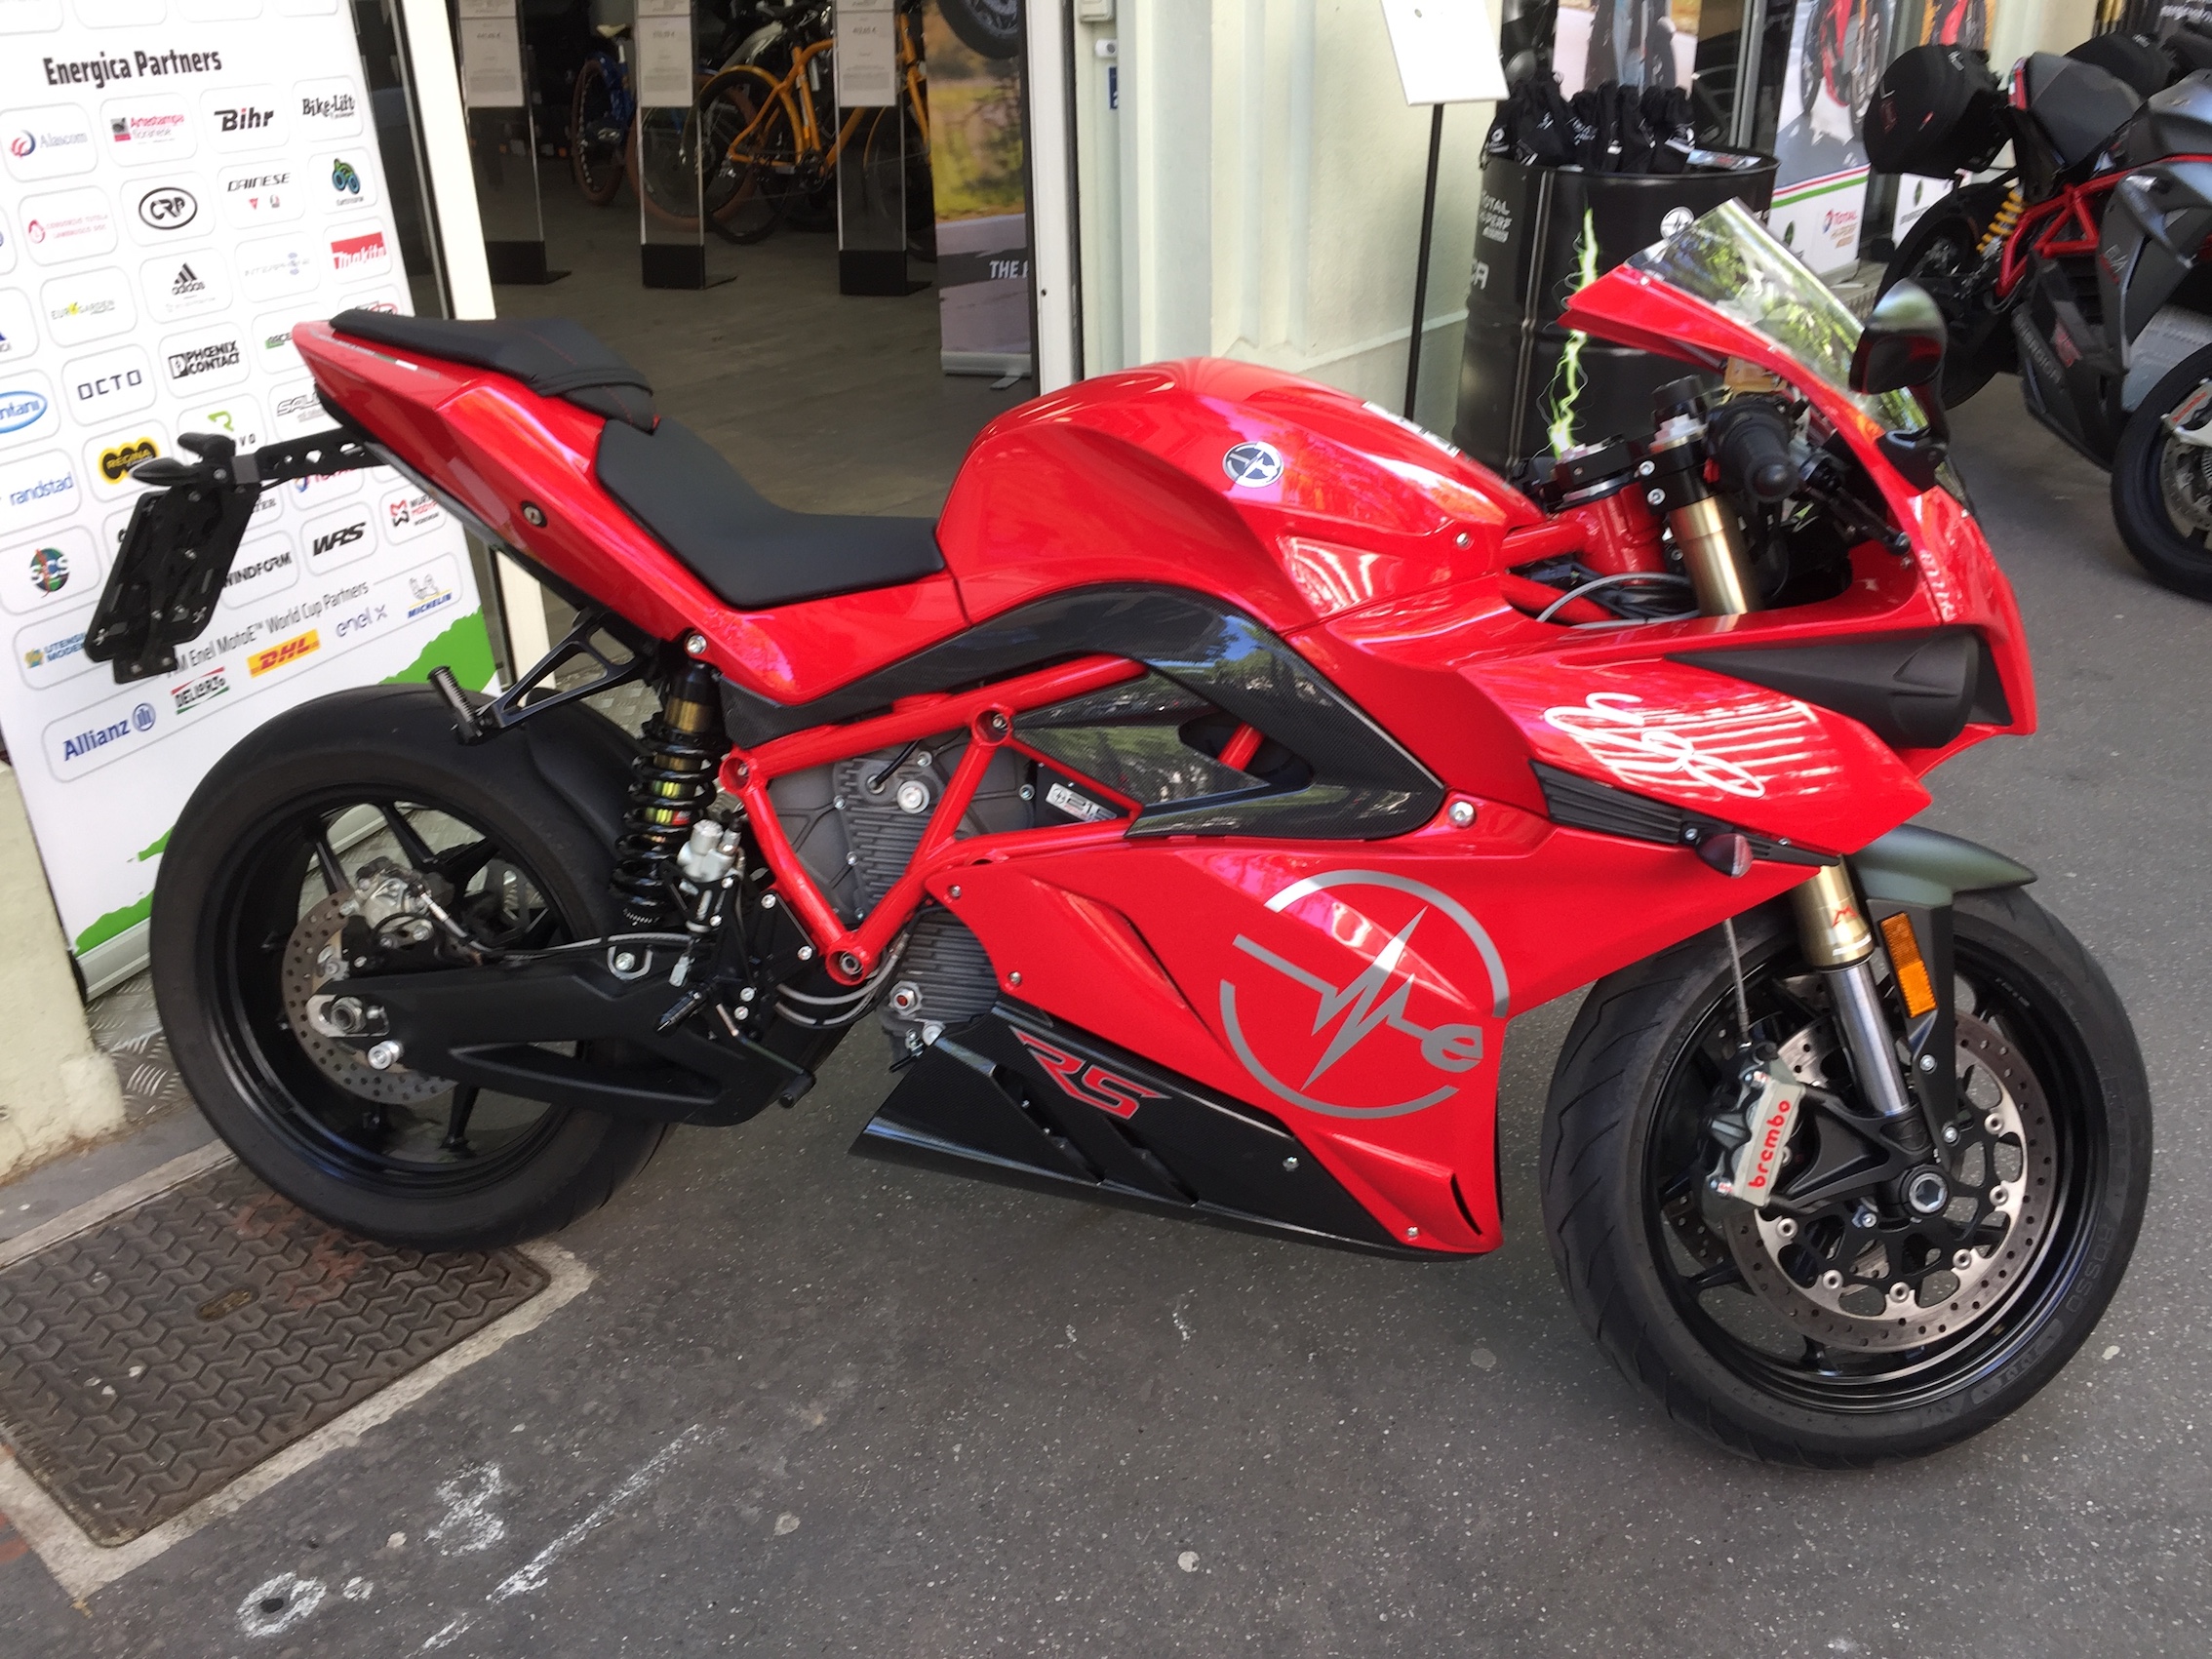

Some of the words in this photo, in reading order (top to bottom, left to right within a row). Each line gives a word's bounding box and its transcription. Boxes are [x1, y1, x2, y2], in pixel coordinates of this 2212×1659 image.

[43, 52, 132, 89] Energica
[135, 48, 222, 78] Partners
[214, 107, 274, 132] Bihr
[227, 173, 291, 192] DAINESE
[150, 197, 186, 219] CRP
[989, 259, 1020, 280] THE
[172, 280, 206, 296] adidas
[77, 370, 142, 400] OCTO
[10, 472, 74, 505] randstad
[313, 521, 367, 556] WRS
[408, 592, 453, 618] MICHELIN
[188, 640, 217, 667] Enel
[265, 607, 300, 634] World
[301, 597, 323, 619] Cup
[323, 581, 369, 611] Partners
[336, 611, 372, 638] enel
[259, 637, 310, 670] DHL
[63, 719, 131, 762] Allianz
[1008, 1025, 1171, 1120] RS
[1748, 1099, 1791, 1189] brembo
